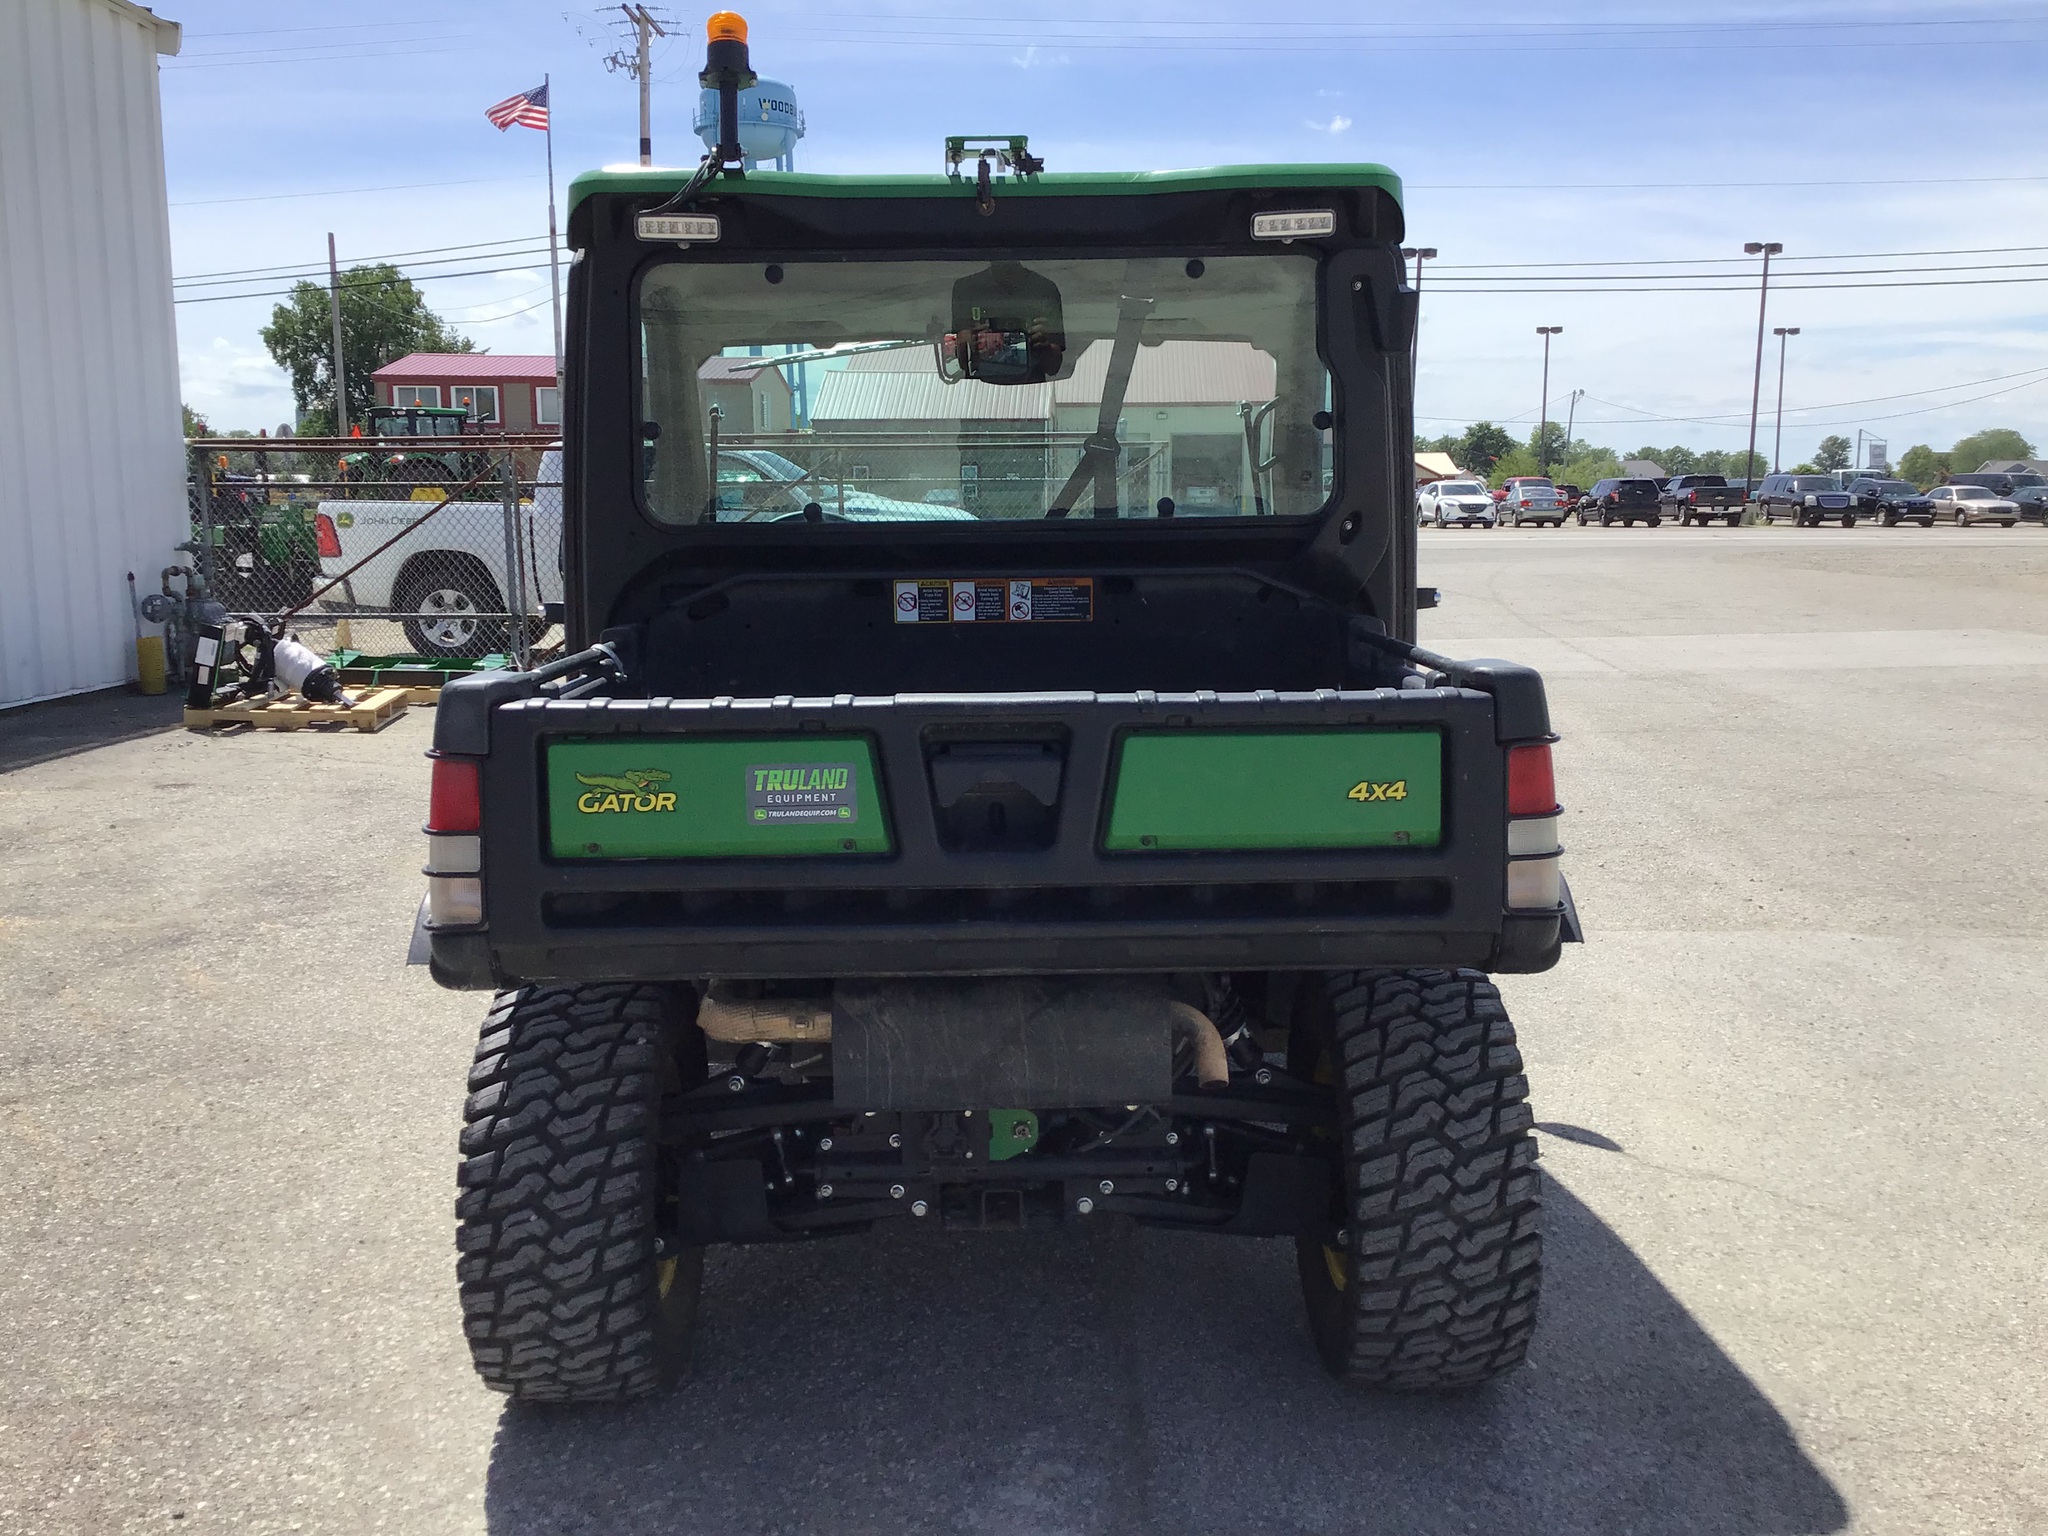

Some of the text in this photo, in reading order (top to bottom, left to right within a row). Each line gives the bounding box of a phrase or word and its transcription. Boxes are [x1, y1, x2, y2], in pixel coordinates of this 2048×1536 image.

[754, 768, 849, 791] TRULAND
[577, 791, 677, 813] GATOR
[767, 793, 837, 803] EQUIPMENT
[768, 809, 837, 818] TRULANDEQUIP.COM
